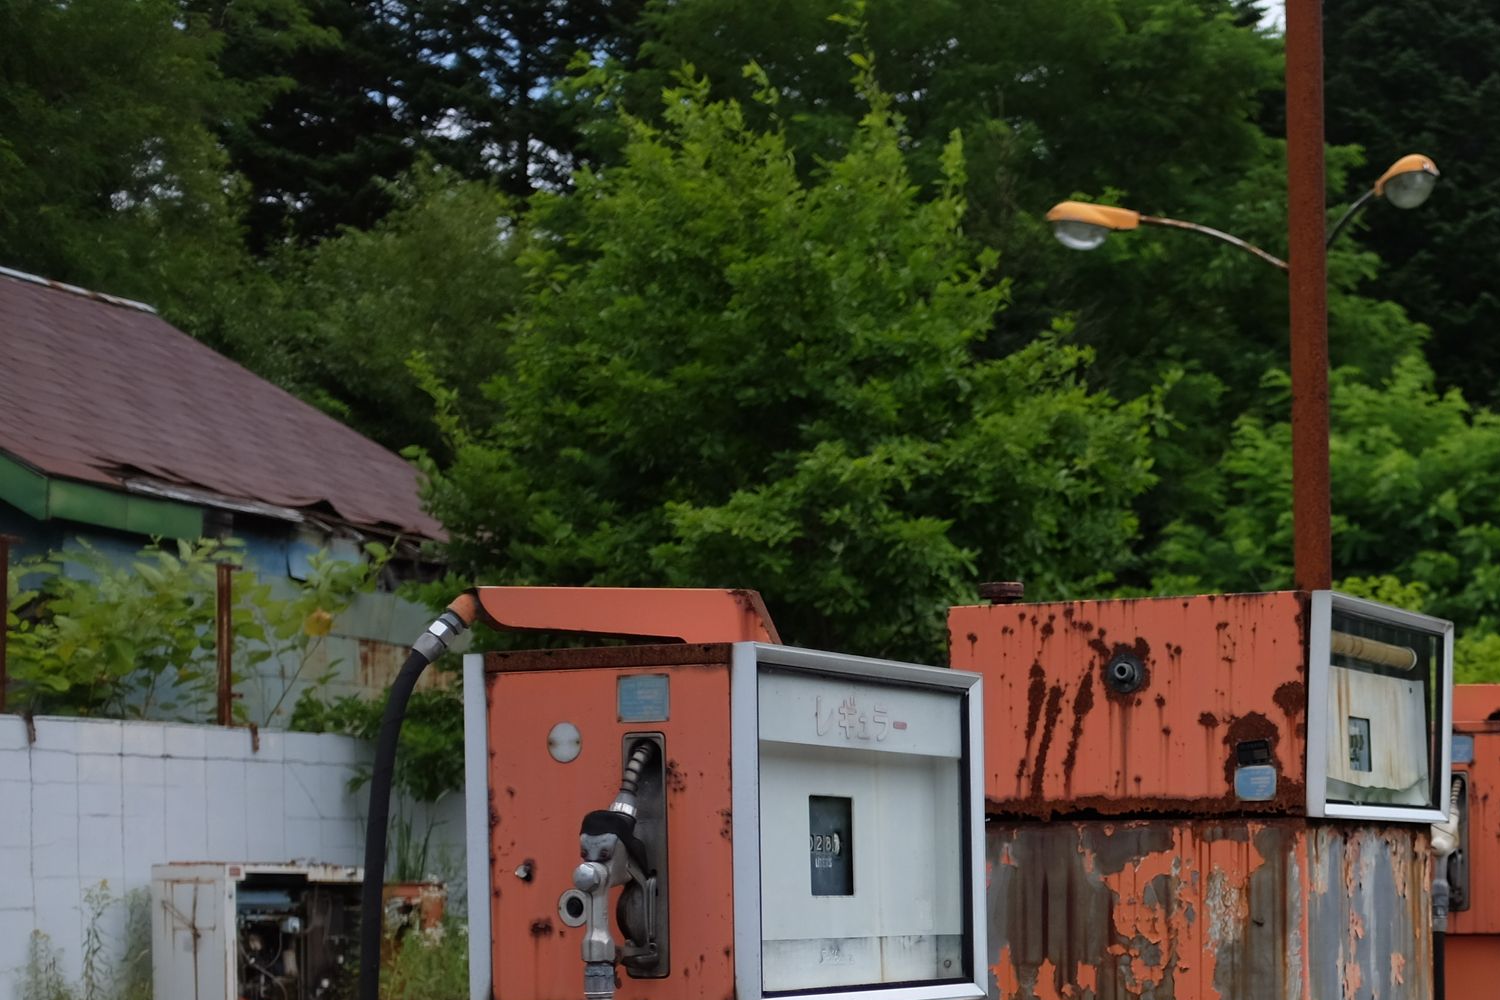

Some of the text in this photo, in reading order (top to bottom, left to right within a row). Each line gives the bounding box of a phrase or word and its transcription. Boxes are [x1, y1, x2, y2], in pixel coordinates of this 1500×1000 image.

[815, 695, 908, 742] レギュラー
